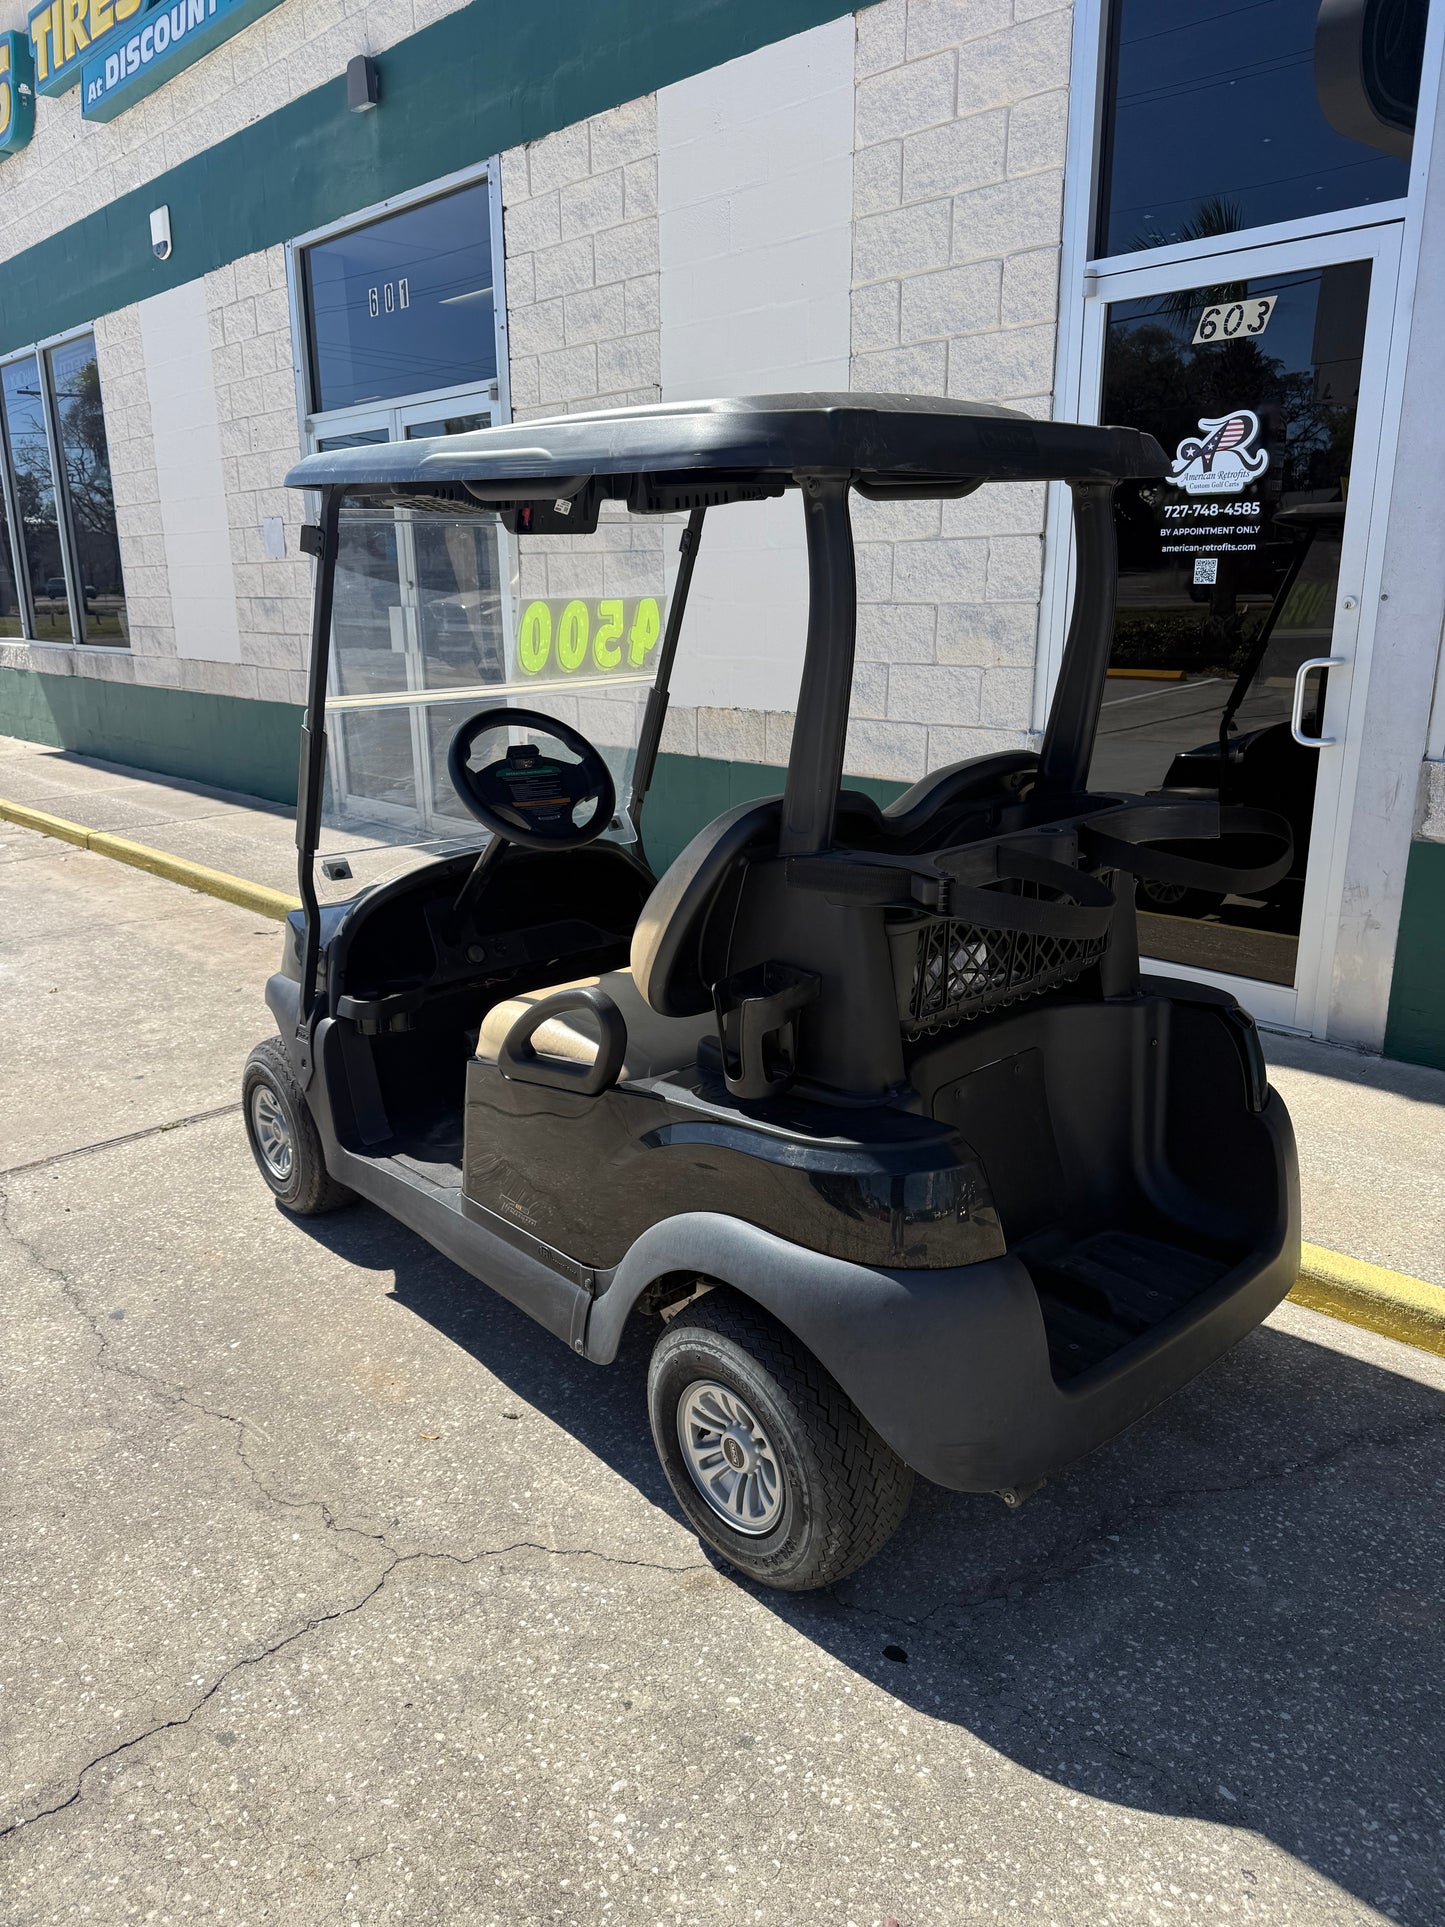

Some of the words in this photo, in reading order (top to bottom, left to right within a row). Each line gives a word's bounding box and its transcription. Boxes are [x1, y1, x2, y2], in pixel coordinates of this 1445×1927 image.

[87, 77, 104, 104] At
[370, 279, 408, 316] 601
[1200, 300, 1270, 340] 603
[1181, 471, 1217, 483] American
[1217, 468, 1251, 482] Retrofits
[1189, 482, 1211, 490] Custom
[1211, 481, 1224, 489] Golf
[1224, 480, 1240, 488] Carts
[1164, 502, 1260, 518] 727-748-4585
[1160, 528, 1172, 537] BY
[1172, 526, 1235, 536] APPOINTMENT
[1236, 525, 1260, 534] ONLY
[1161, 543, 1256, 553] american-retrofits.com
